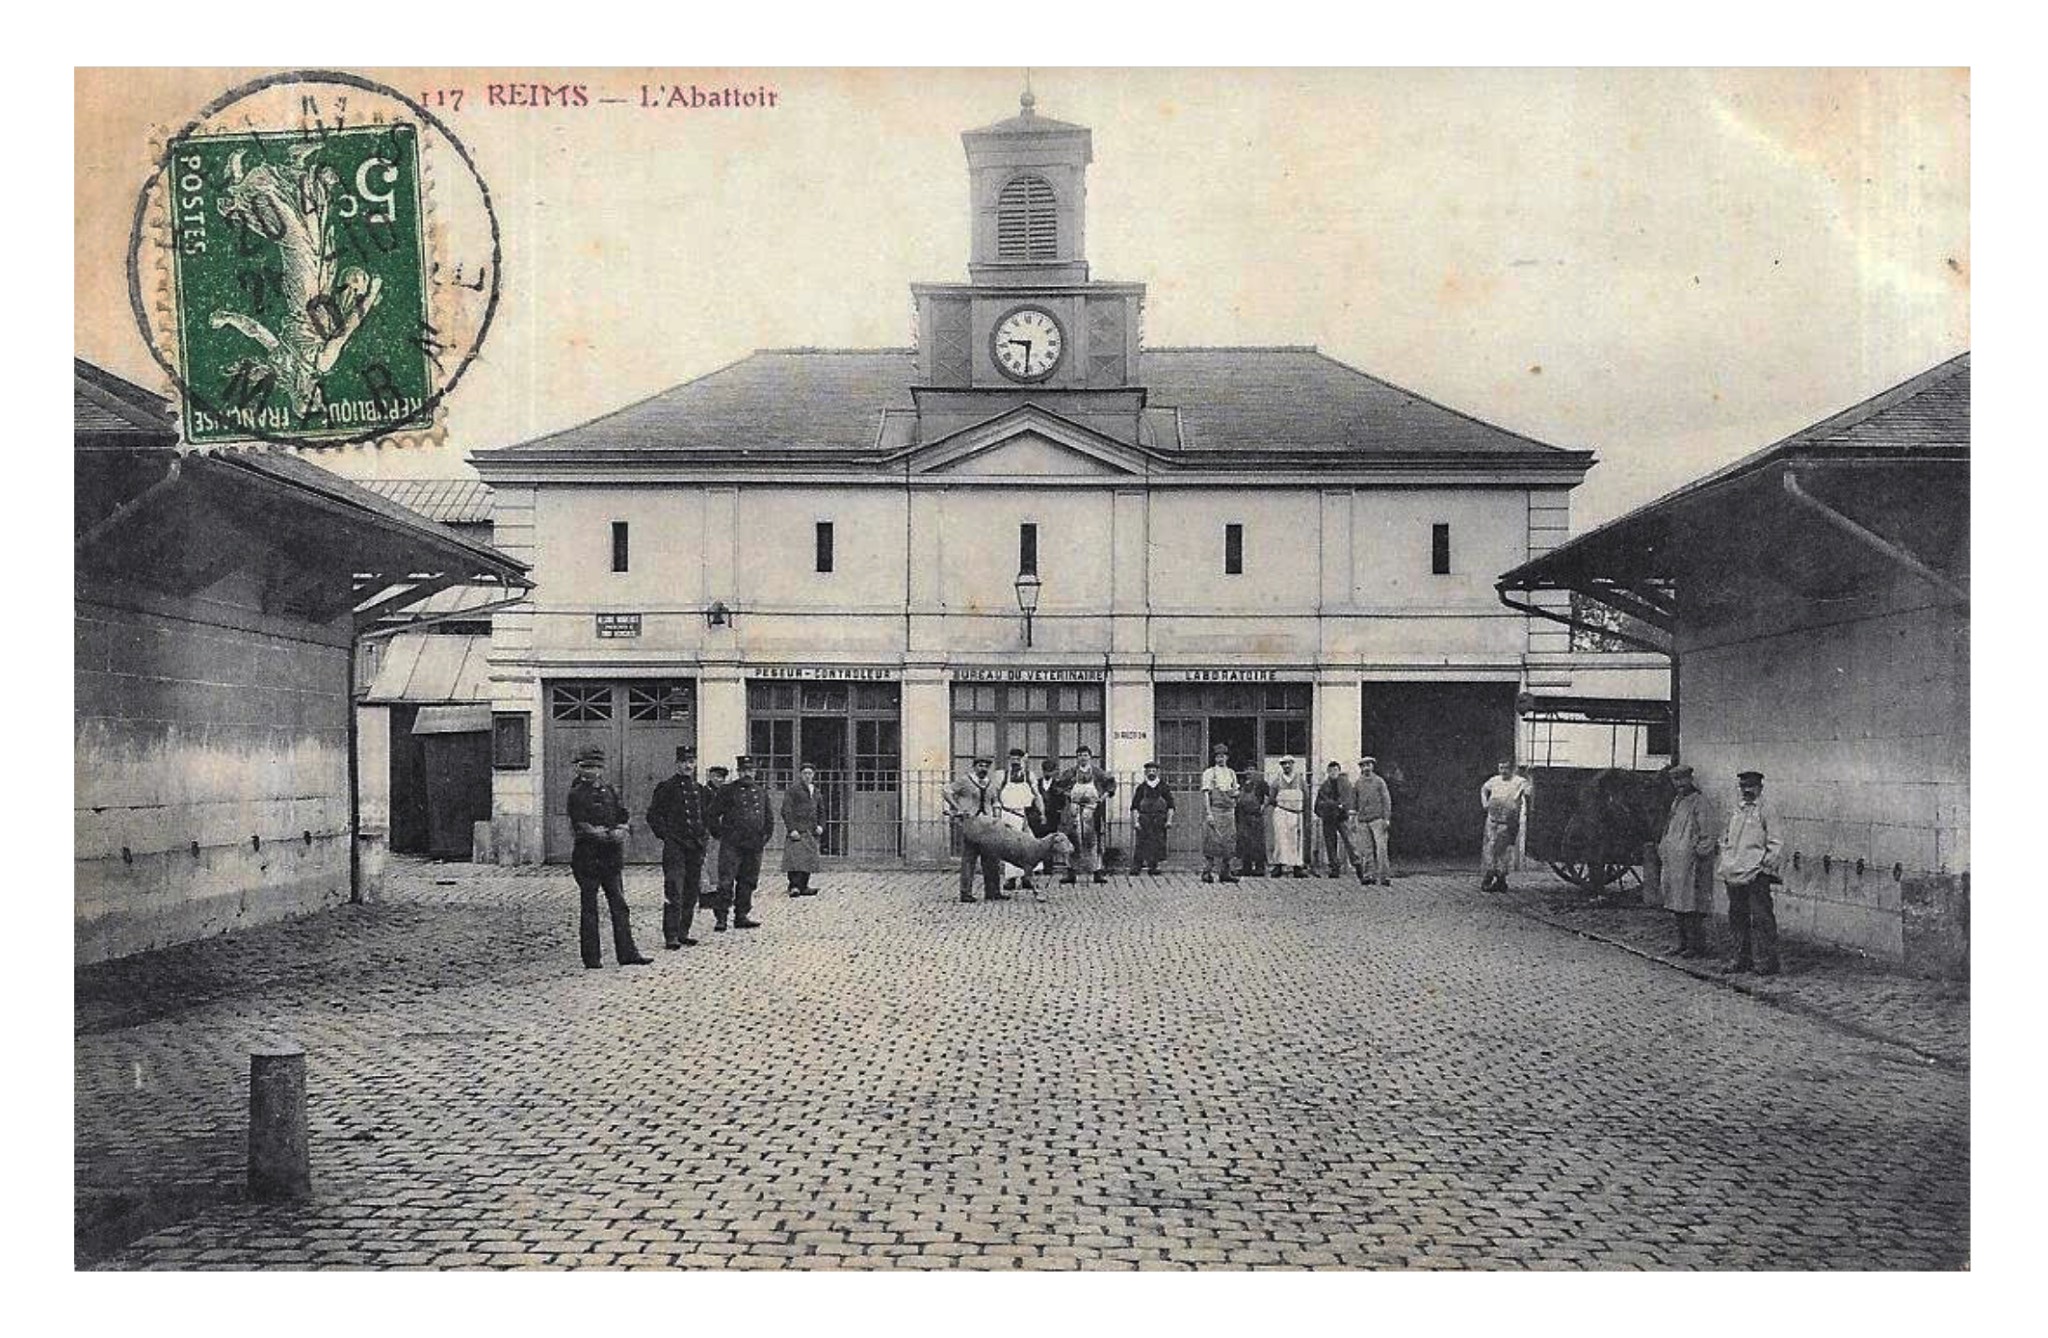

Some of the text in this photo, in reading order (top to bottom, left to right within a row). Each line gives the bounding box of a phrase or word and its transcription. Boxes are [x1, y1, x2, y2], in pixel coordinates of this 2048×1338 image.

[181, 155, 206, 254] POSTES
[319, 399, 423, 426] REPBLIQU
[1008, 670, 1022, 681] DU
[1185, 669, 1277, 681] LABORATOIRE
